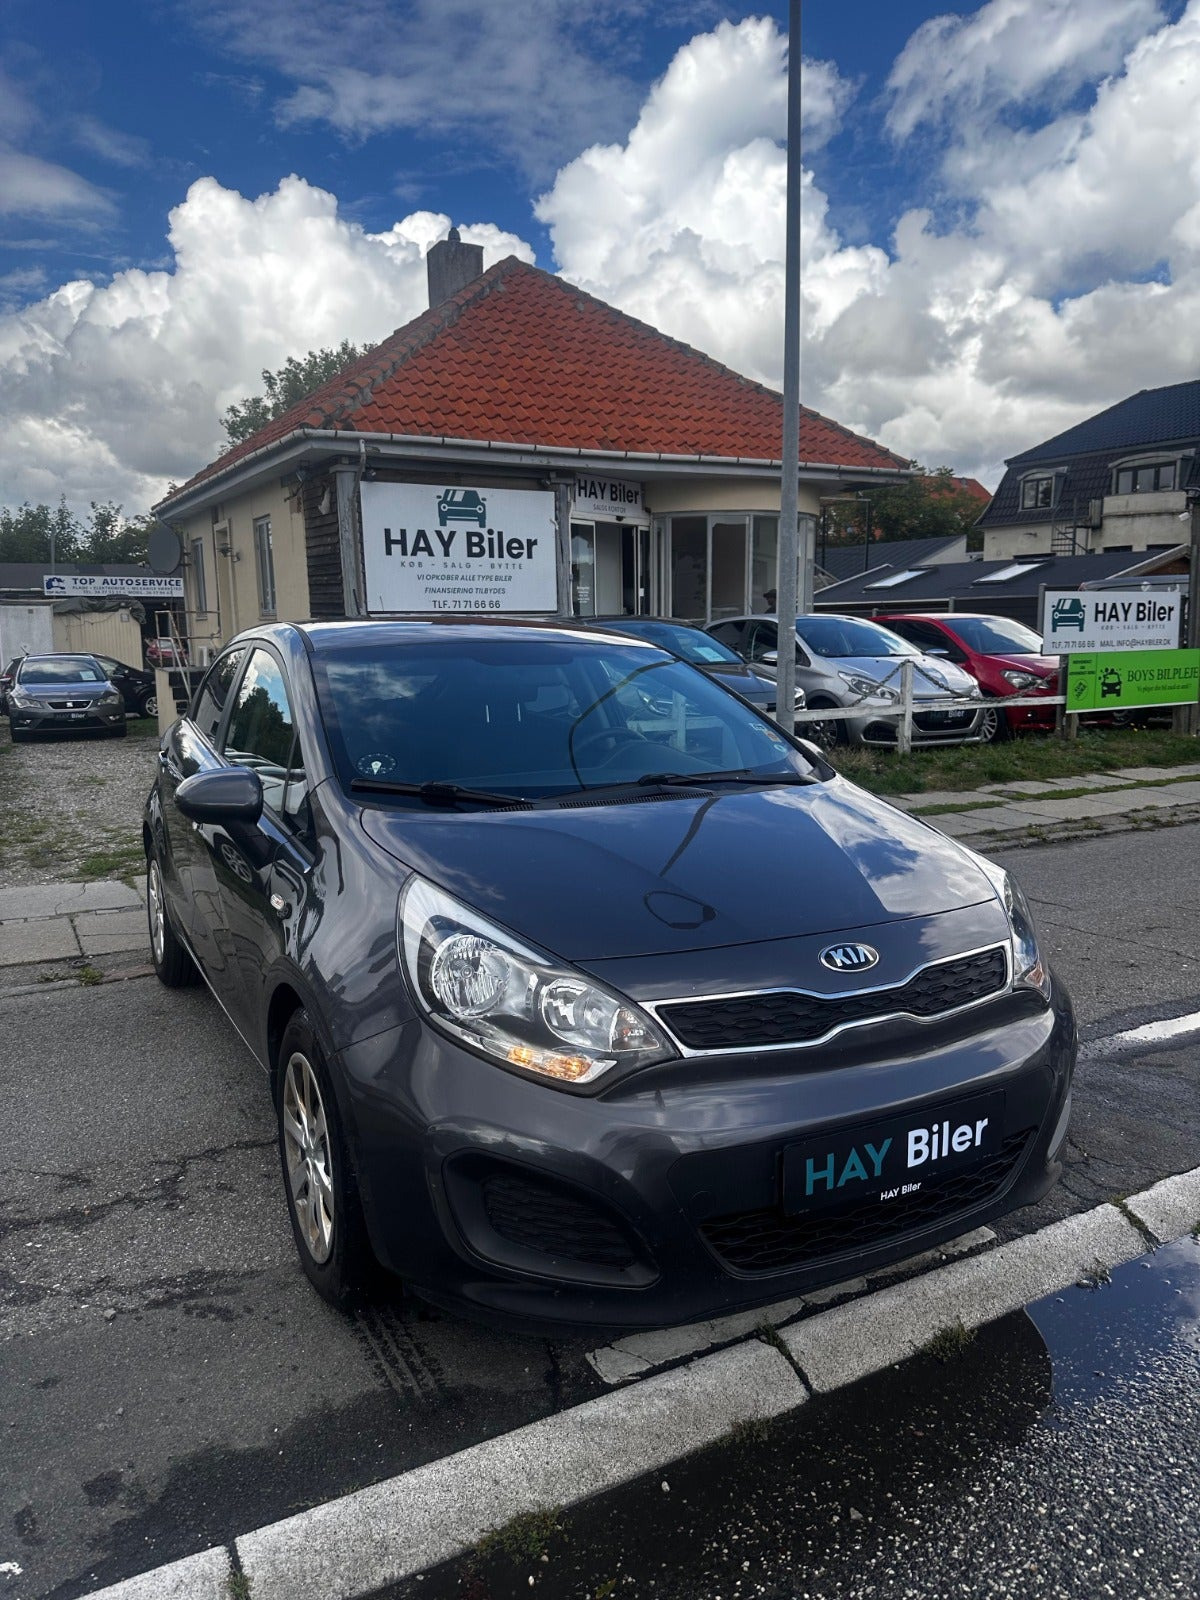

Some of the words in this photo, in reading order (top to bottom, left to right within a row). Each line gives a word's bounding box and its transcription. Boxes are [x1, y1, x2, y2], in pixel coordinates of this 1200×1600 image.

[577, 479, 607, 500] HAY
[610, 483, 640, 504] Biler
[384, 528, 456, 557] HAY
[467, 528, 538, 560] Biler
[102, 578, 181, 586] AUTOSERVICE
[432, 600, 451, 608] TLF.
[453, 600, 461, 608] 71
[464, 600, 472, 608] 71
[474, 600, 486, 608] 66
[488, 600, 501, 608] 66
[1094, 602, 1132, 622] HAY
[1136, 600, 1174, 622] Biler
[1128, 670, 1154, 682] BOYS
[1157, 666, 1198, 680] BILPLEJE
[828, 946, 875, 966] KIA
[805, 1138, 892, 1196] HAY
[907, 1118, 989, 1168] Biler
[880, 1187, 900, 1200] HAY
[902, 1182, 922, 1194] Biler
